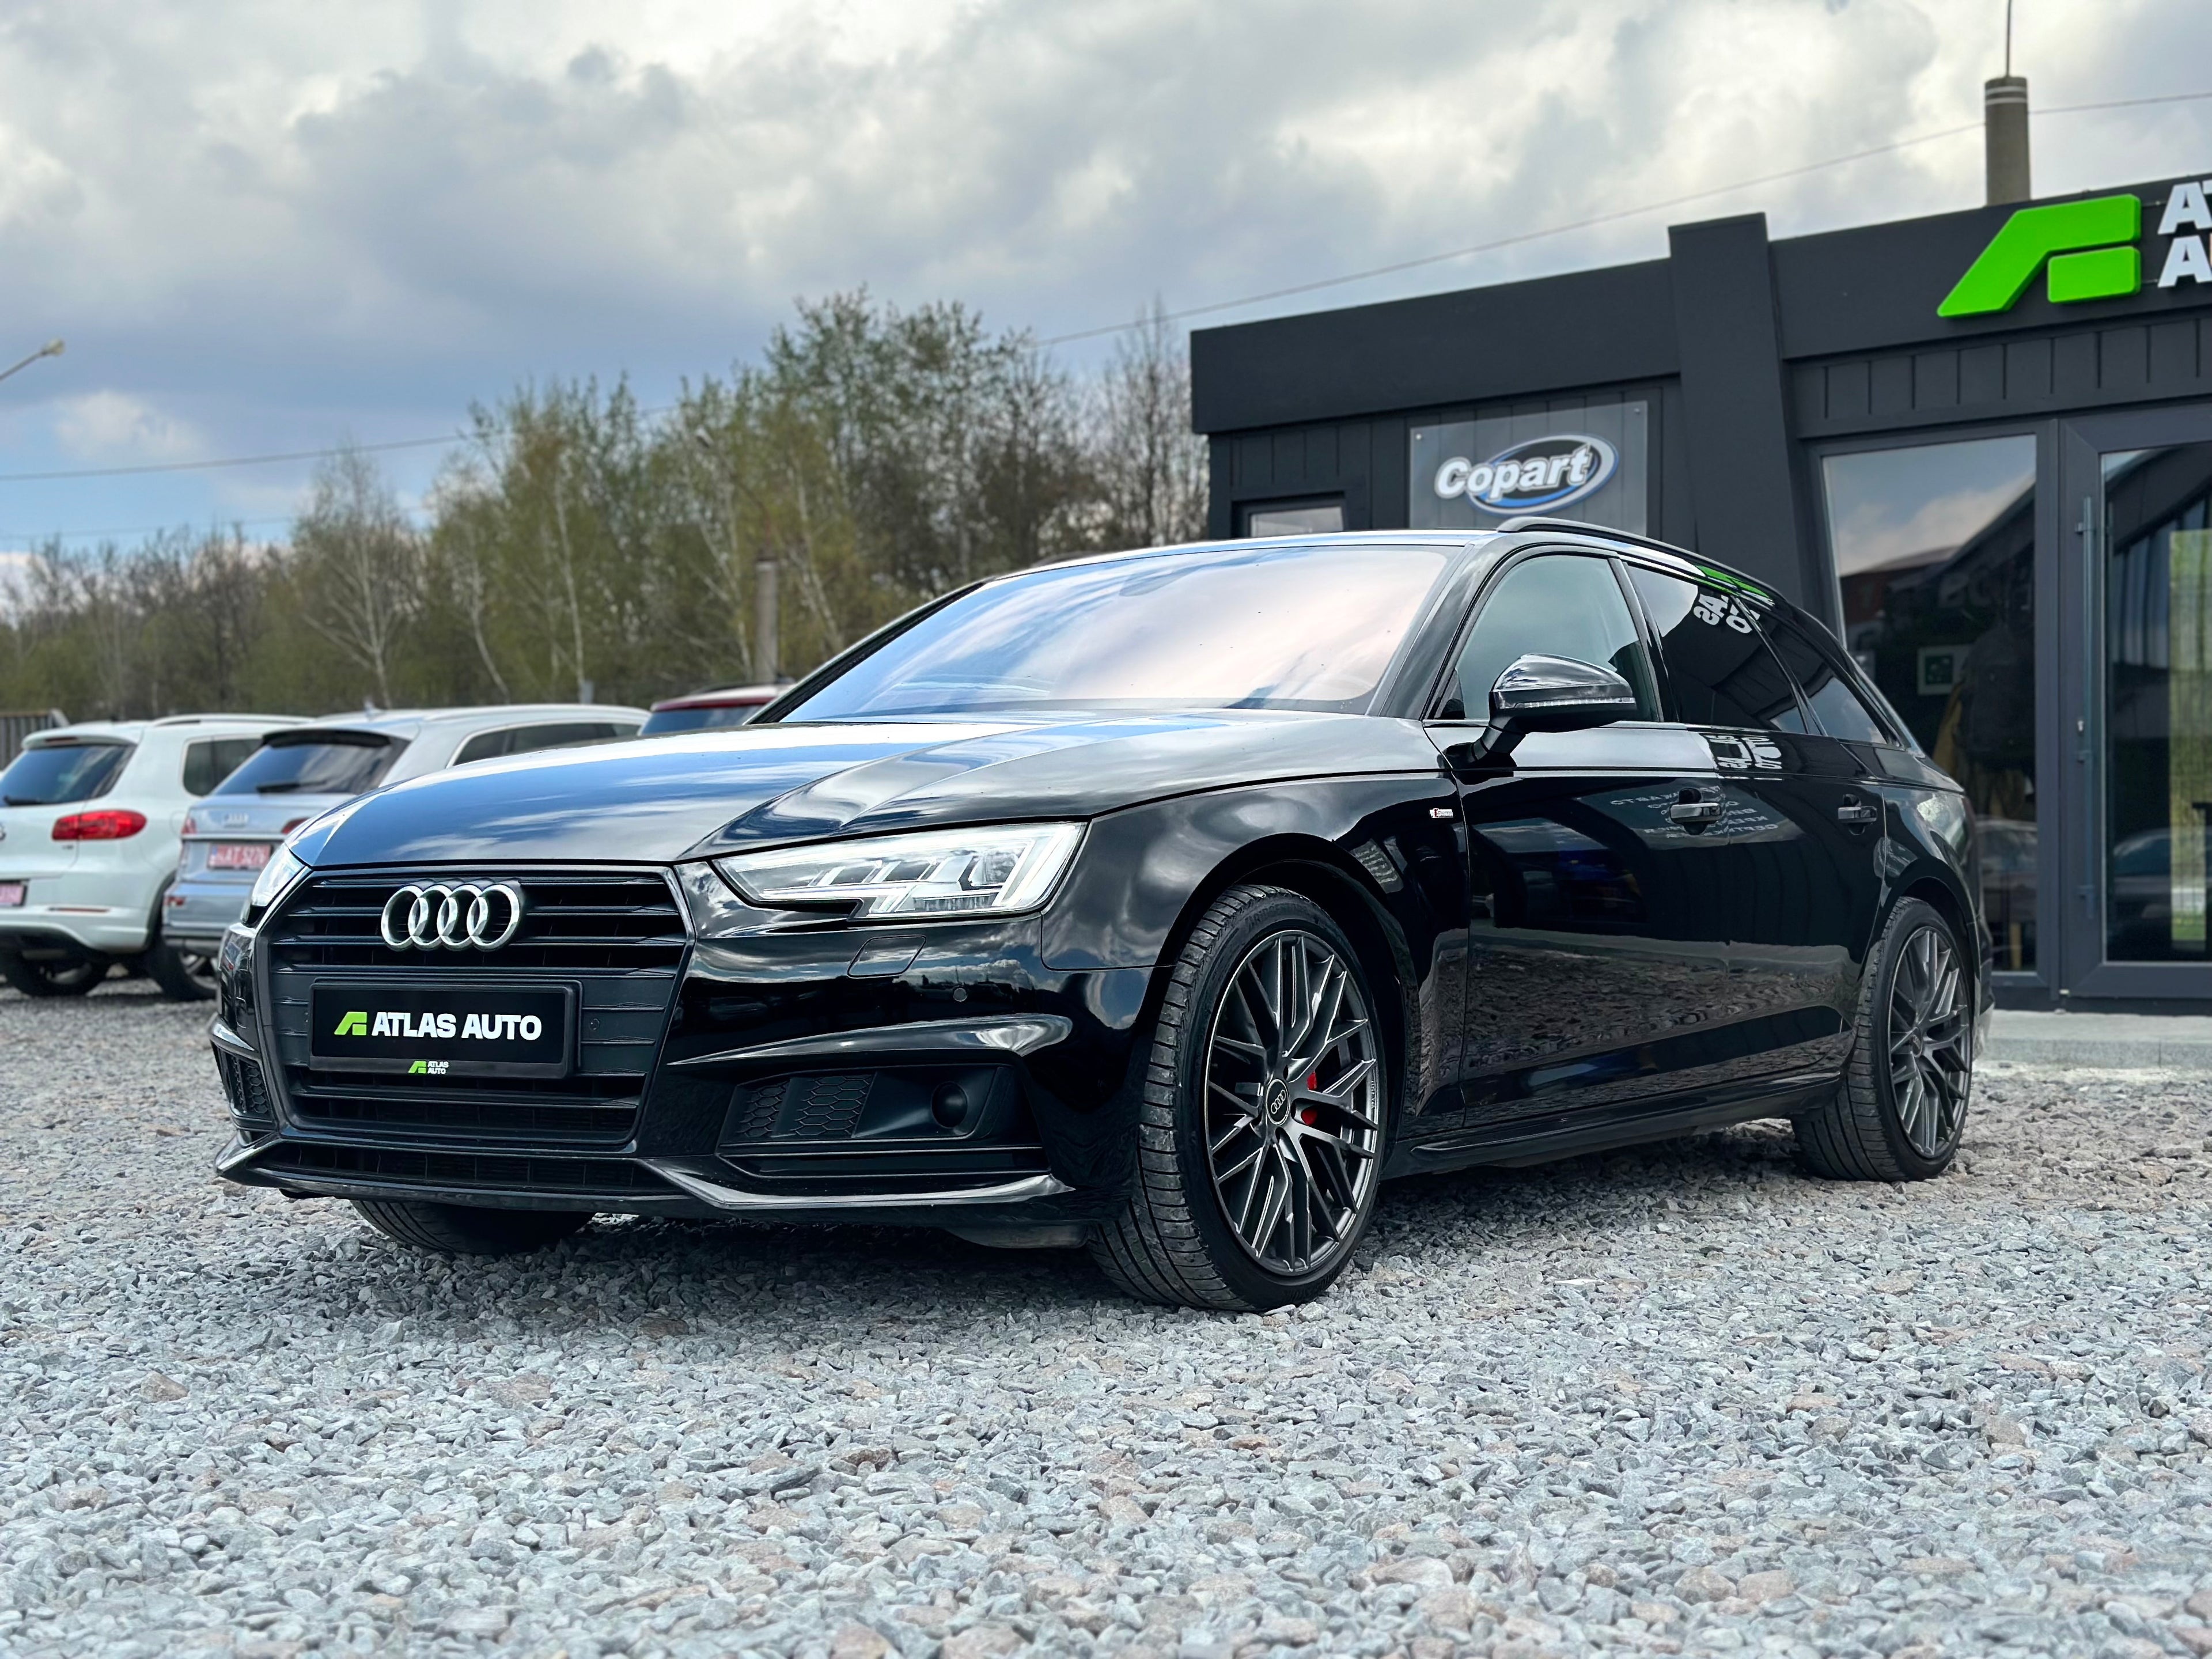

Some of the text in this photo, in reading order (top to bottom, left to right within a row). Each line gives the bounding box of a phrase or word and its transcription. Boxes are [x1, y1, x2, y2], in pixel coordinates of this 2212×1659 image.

[2157, 234, 2212, 287] A
[1435, 442, 1592, 502] Copart
[372, 1012, 542, 1040] ATLAS AUTO
